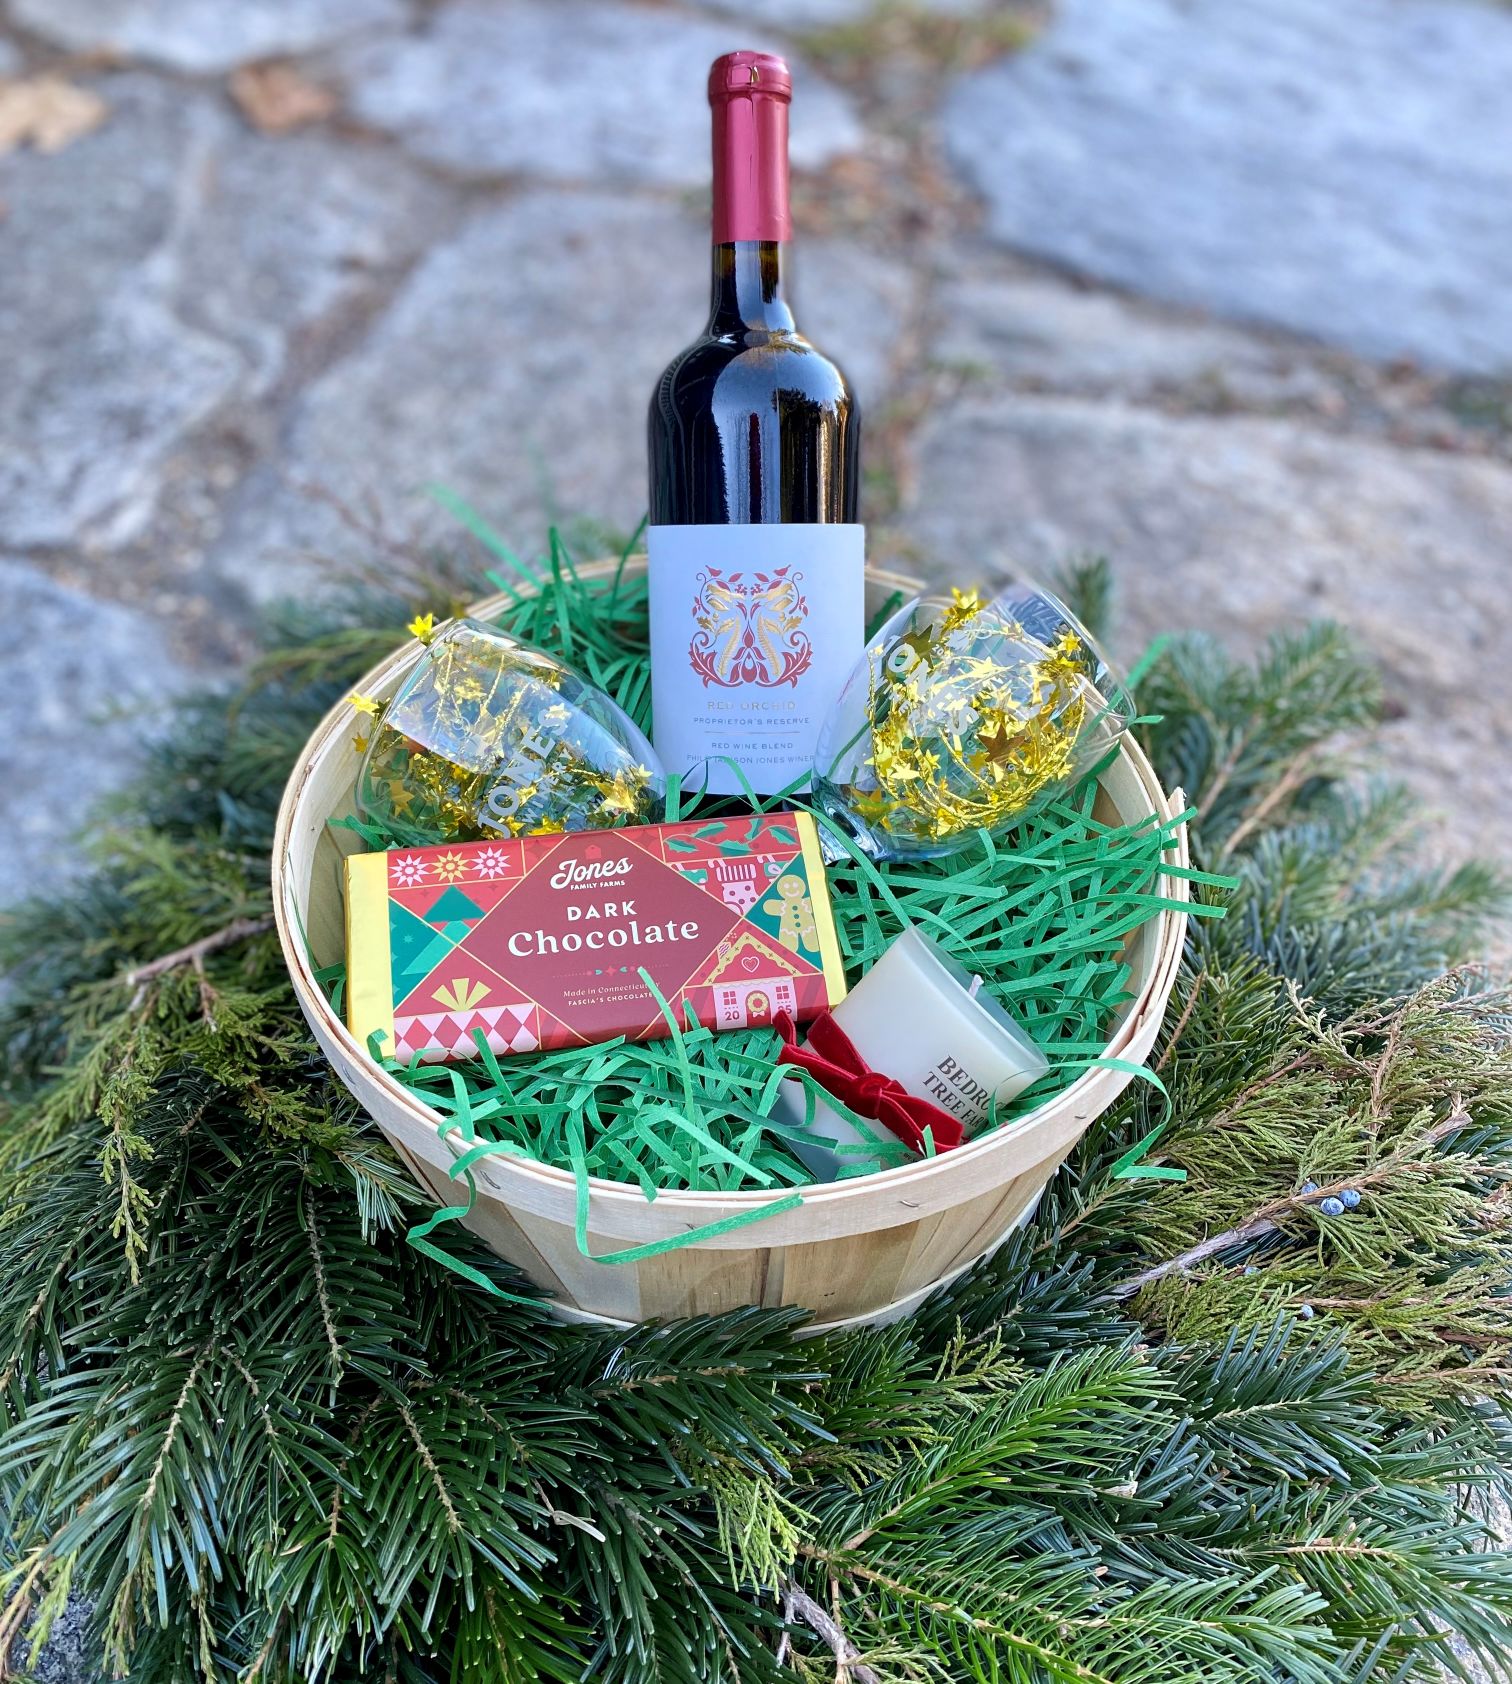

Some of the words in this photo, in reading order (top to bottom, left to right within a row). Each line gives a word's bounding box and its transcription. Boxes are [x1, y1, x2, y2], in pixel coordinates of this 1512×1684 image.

[707, 701, 734, 711] RED
[740, 701, 796, 711] ORCHID
[693, 717, 763, 726] PROPRIETOR'S
[766, 717, 810, 726] RESERVE
[711, 742, 730, 750] RED
[733, 742, 758, 750] WINE
[761, 742, 794, 750] BLEND
[756, 756, 785, 764] JONES
[477, 708, 568, 839] JONES
[550, 857, 634, 890] Jones
[570, 883, 597, 891] FAMILY
[600, 880, 626, 888] FARMS
[566, 900, 637, 921] DARK
[507, 920, 700, 957] Chocolate
[563, 987, 586, 998] Made
[587, 986, 597, 996] in
[568, 996, 604, 1006] FASCIA'S
[724, 1011, 740, 1021] 20
[922, 1071, 965, 1114] TREE
